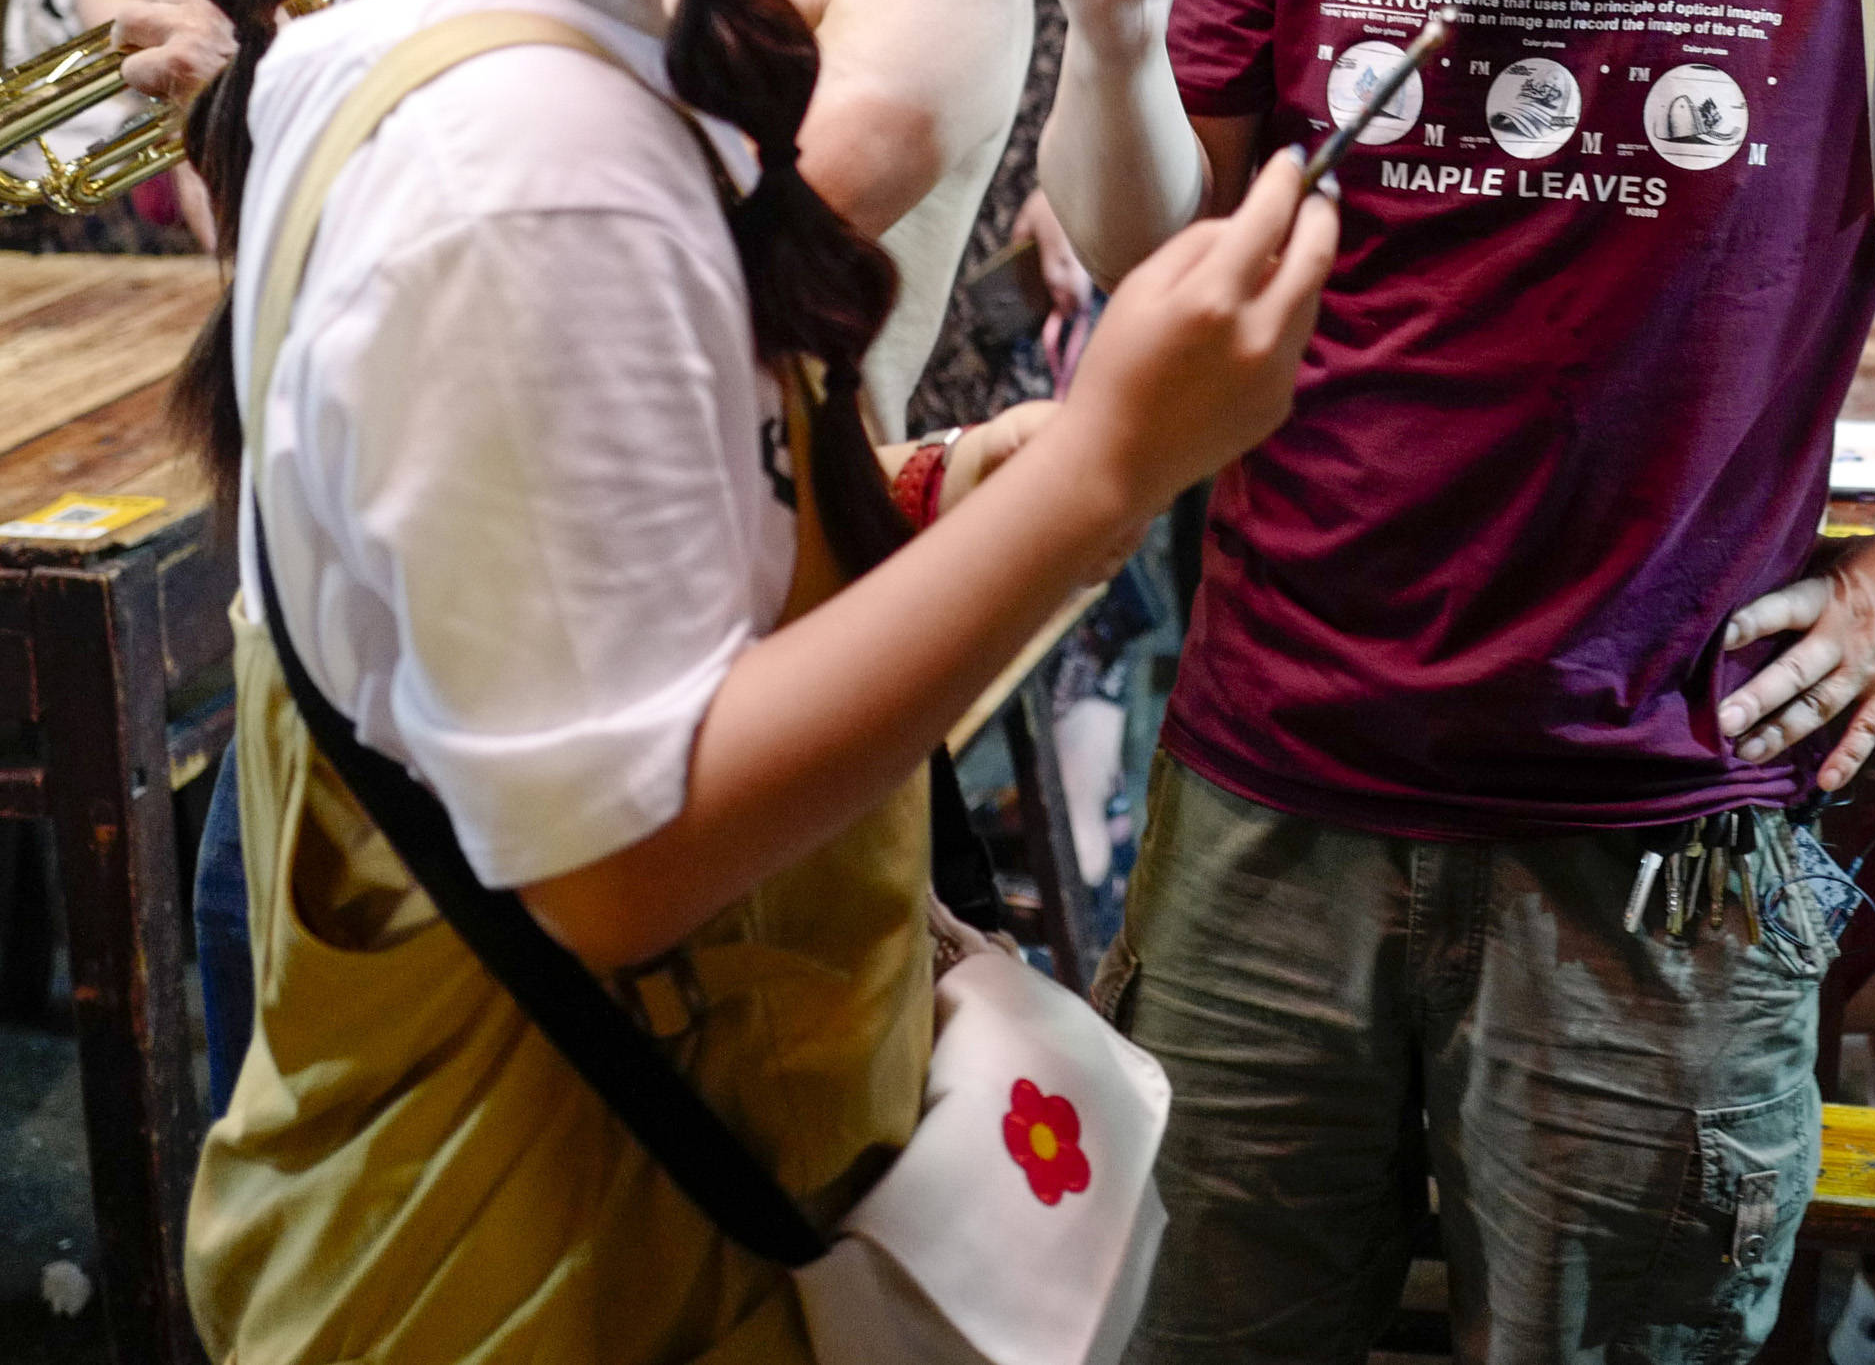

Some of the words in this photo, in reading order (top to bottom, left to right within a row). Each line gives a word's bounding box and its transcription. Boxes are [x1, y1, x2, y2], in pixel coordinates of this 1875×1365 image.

[1478, 14, 1496, 25] an
[1500, 13, 1543, 30] image
[1546, 17, 1572, 29] and
[1574, 18, 1620, 31] record
[1622, 18, 1645, 30] the
[1648, 18, 1692, 35] image
[1694, 22, 1711, 34] of
[1712, 23, 1736, 36] the
[1534, 0, 1567, 11] uses
[1569, 0, 1591, 12] the
[1593, 0, 1655, 15] principle
[1657, 0, 1675, 13] of
[1676, 2, 1725, 17] optical
[1726, 5, 1783, 26] imaging
[1522, 38, 1543, 47] Color
[1469, 60, 1491, 75] FM
[1629, 66, 1651, 82] FM
[1424, 123, 1446, 147] M
[1580, 131, 1604, 155] M
[1747, 143, 1769, 166] M
[1381, 160, 1506, 196] MAPLE
[1518, 170, 1668, 206] LEAVES
